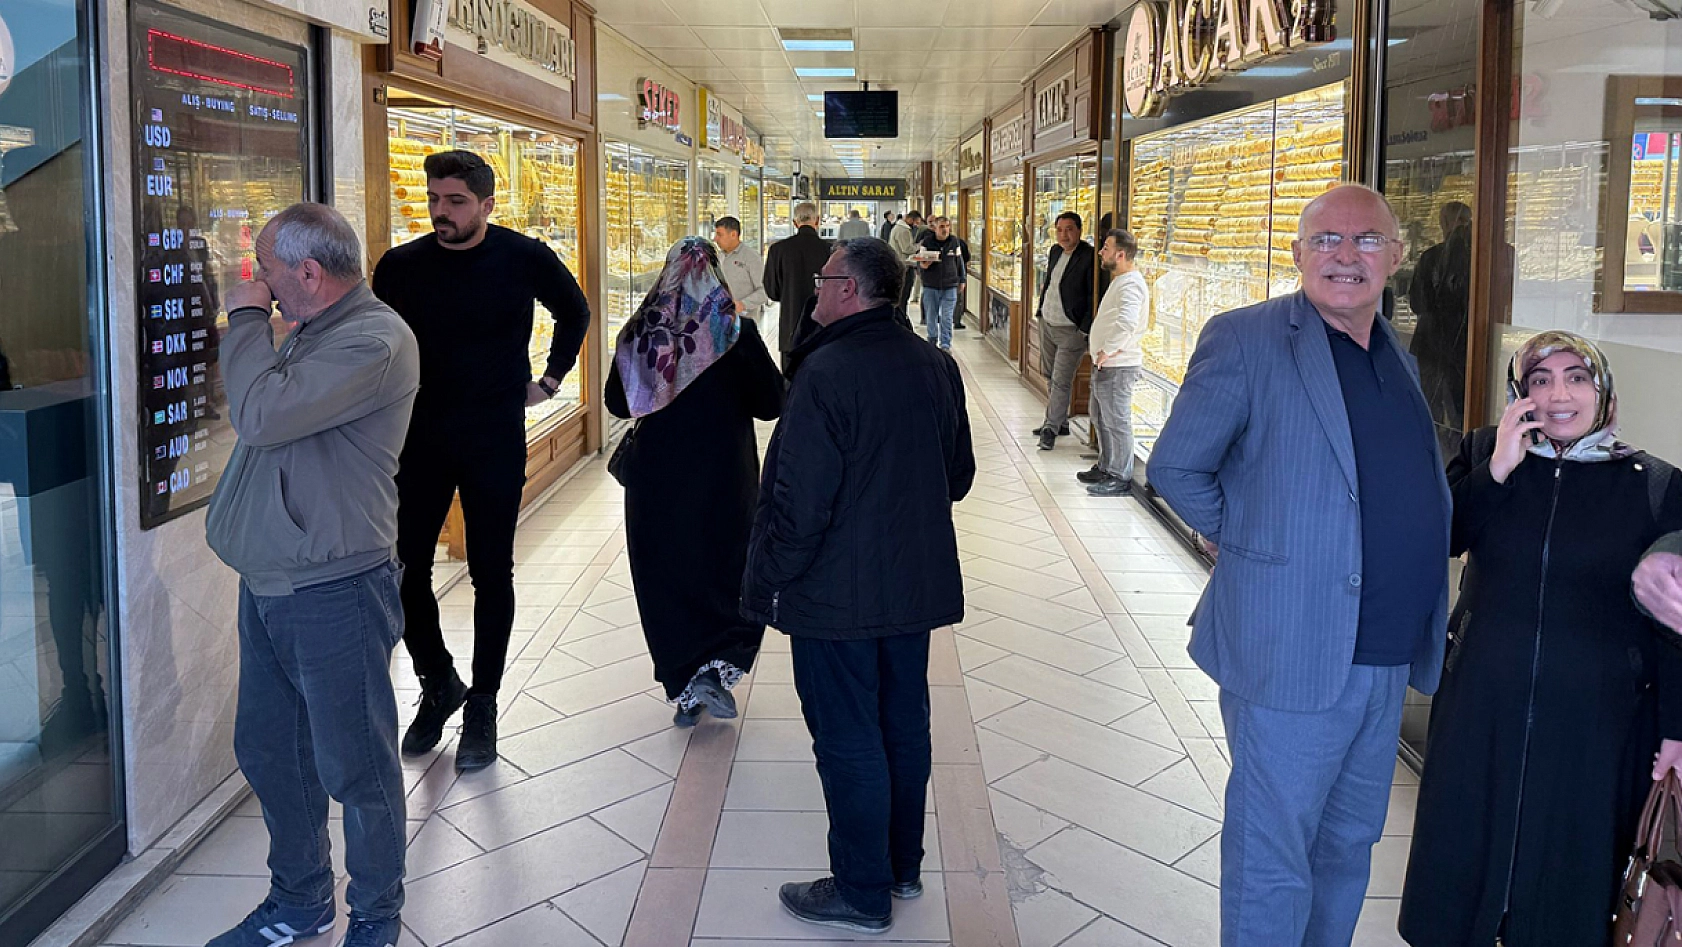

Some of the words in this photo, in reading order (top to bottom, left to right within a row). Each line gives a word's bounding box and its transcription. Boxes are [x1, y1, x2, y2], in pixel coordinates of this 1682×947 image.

[205, 97, 235, 113] BUYING
[144, 124, 171, 148] USD
[147, 175, 173, 197] EUR
[828, 184, 860, 196] ALTIN
[162, 229, 184, 250] GBP
[164, 264, 185, 285] CHF
[165, 298, 185, 320] SEK
[165, 332, 186, 355] DKK
[166, 366, 189, 390] NOK
[168, 400, 188, 425] SAR
[169, 434, 189, 459] AUD
[169, 467, 190, 494] CAD
